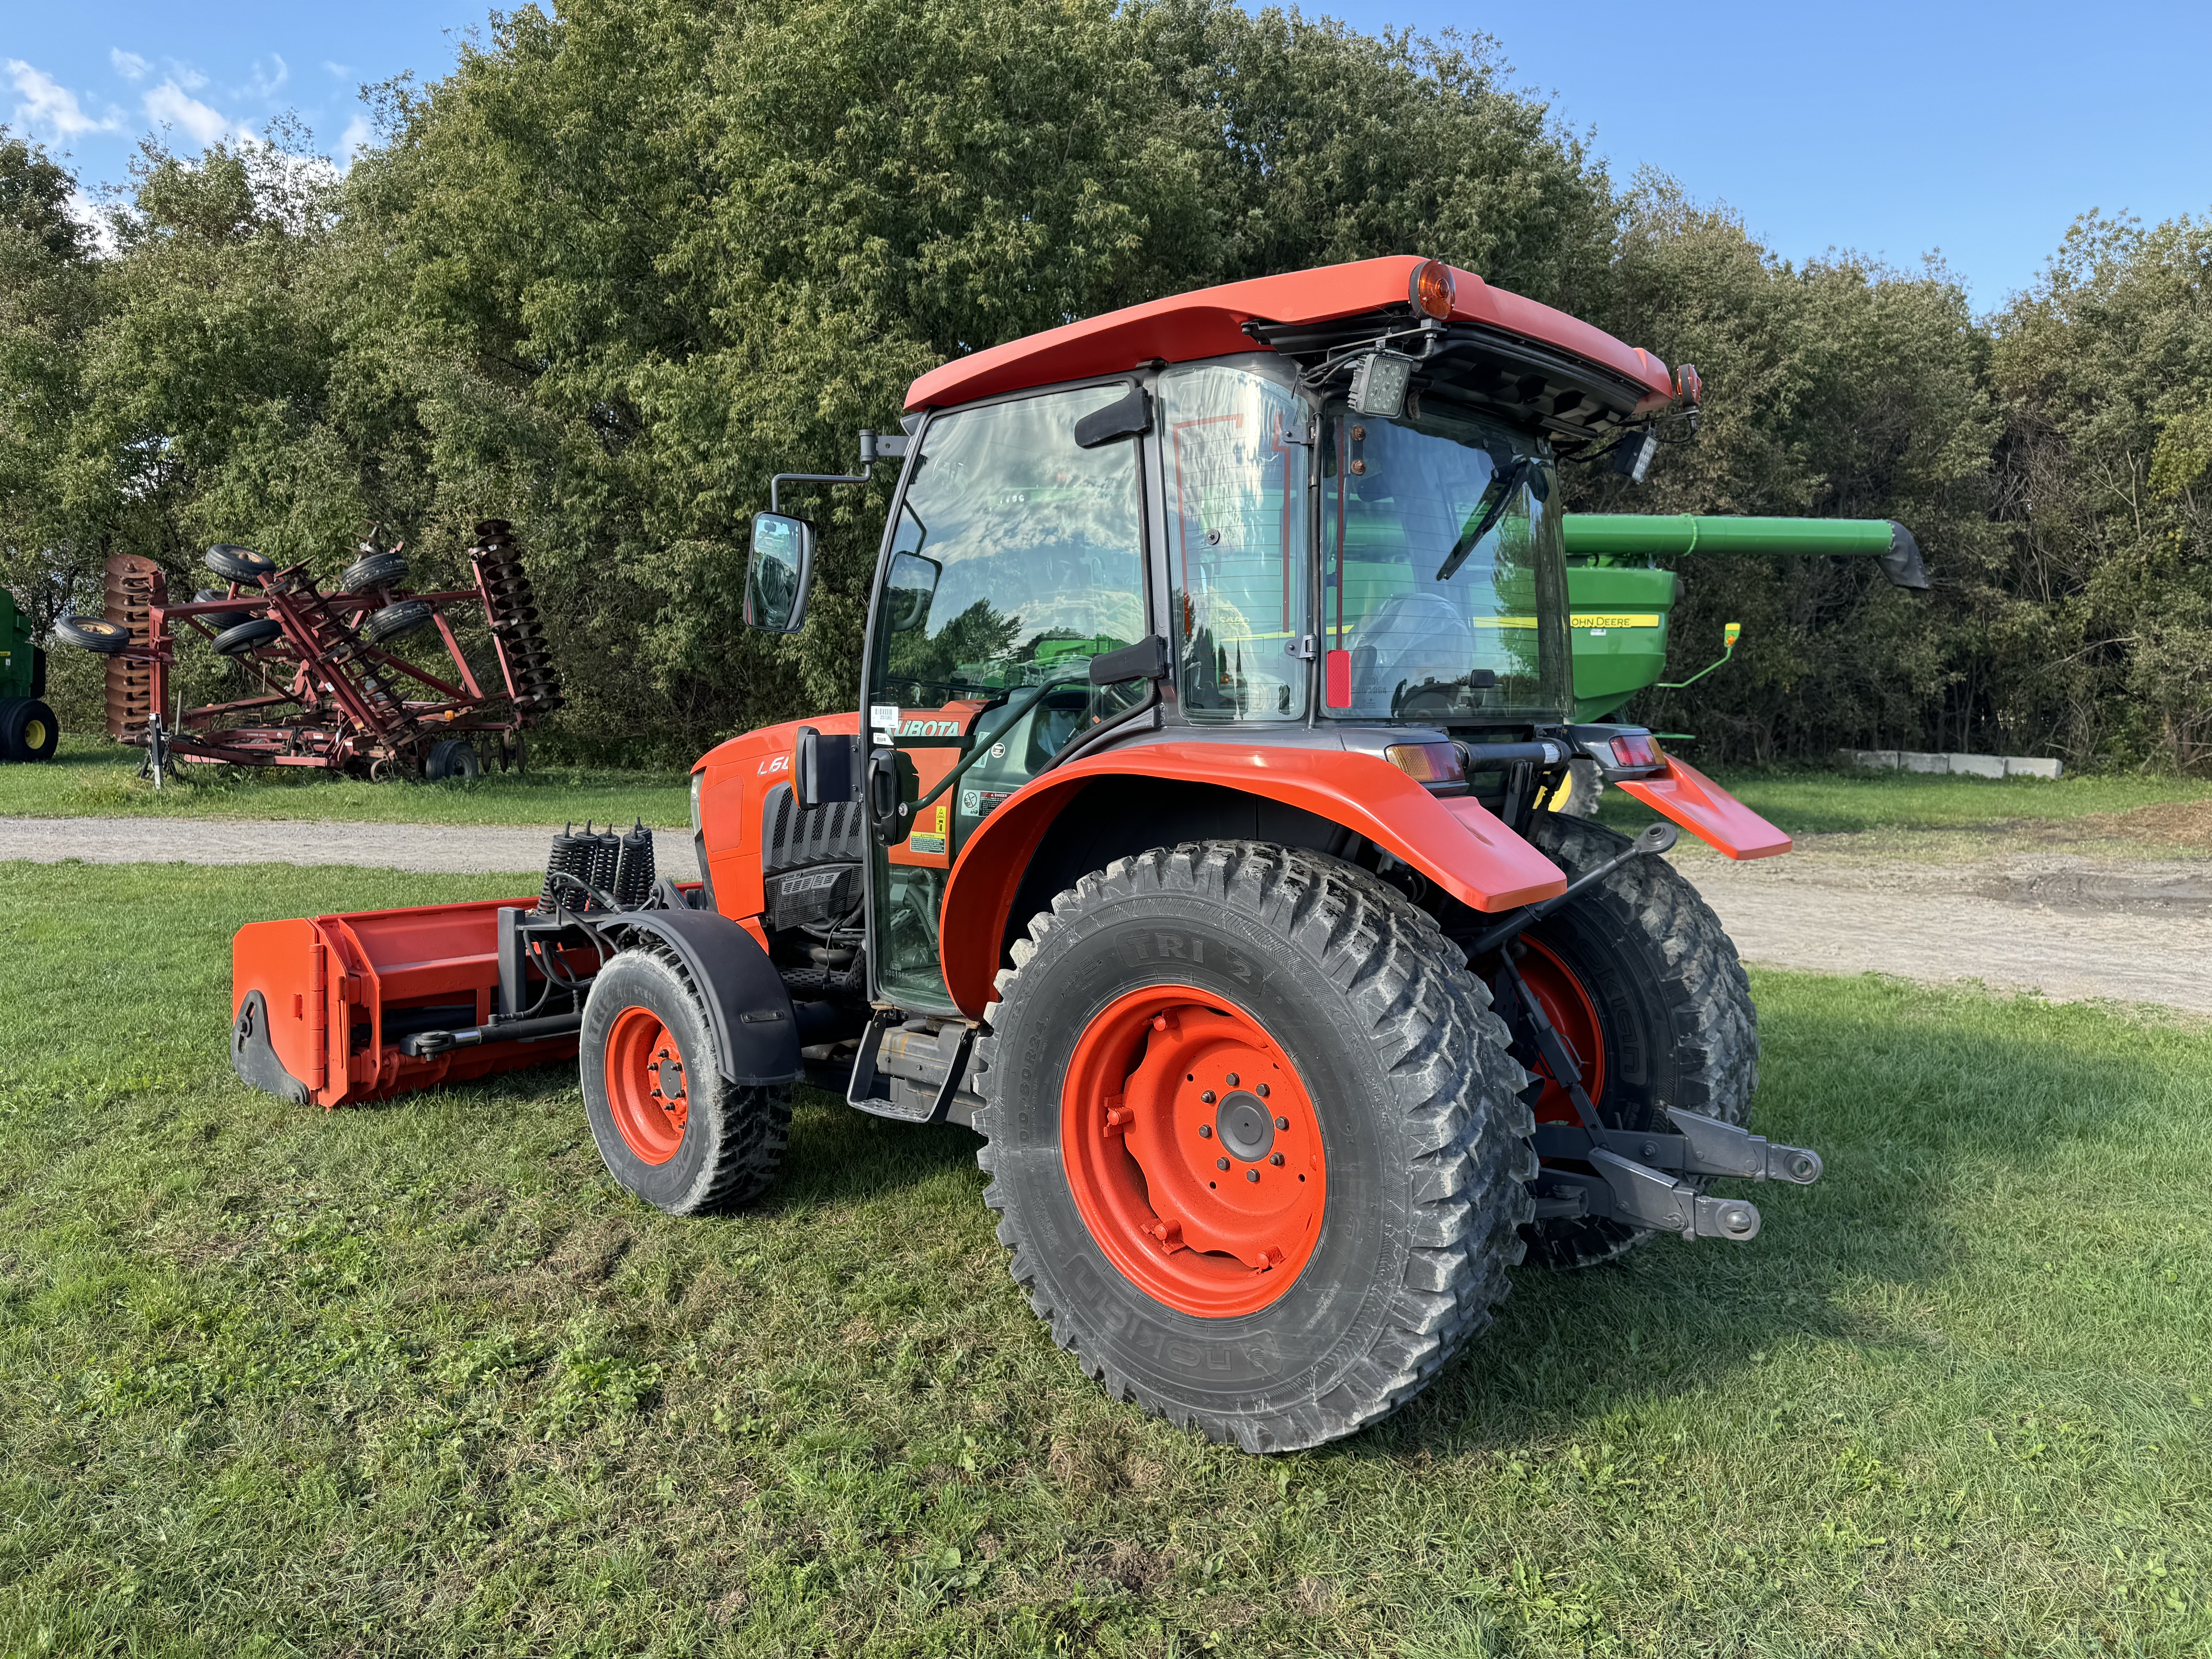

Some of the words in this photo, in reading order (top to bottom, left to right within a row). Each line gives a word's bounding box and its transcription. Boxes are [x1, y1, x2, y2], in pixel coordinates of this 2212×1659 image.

[1596, 617, 1630, 626] DEERE
[1127, 933, 1204, 964] TRI
[1228, 958, 1252, 984] 2
[1348, 1035, 1391, 1128] ROTATION
